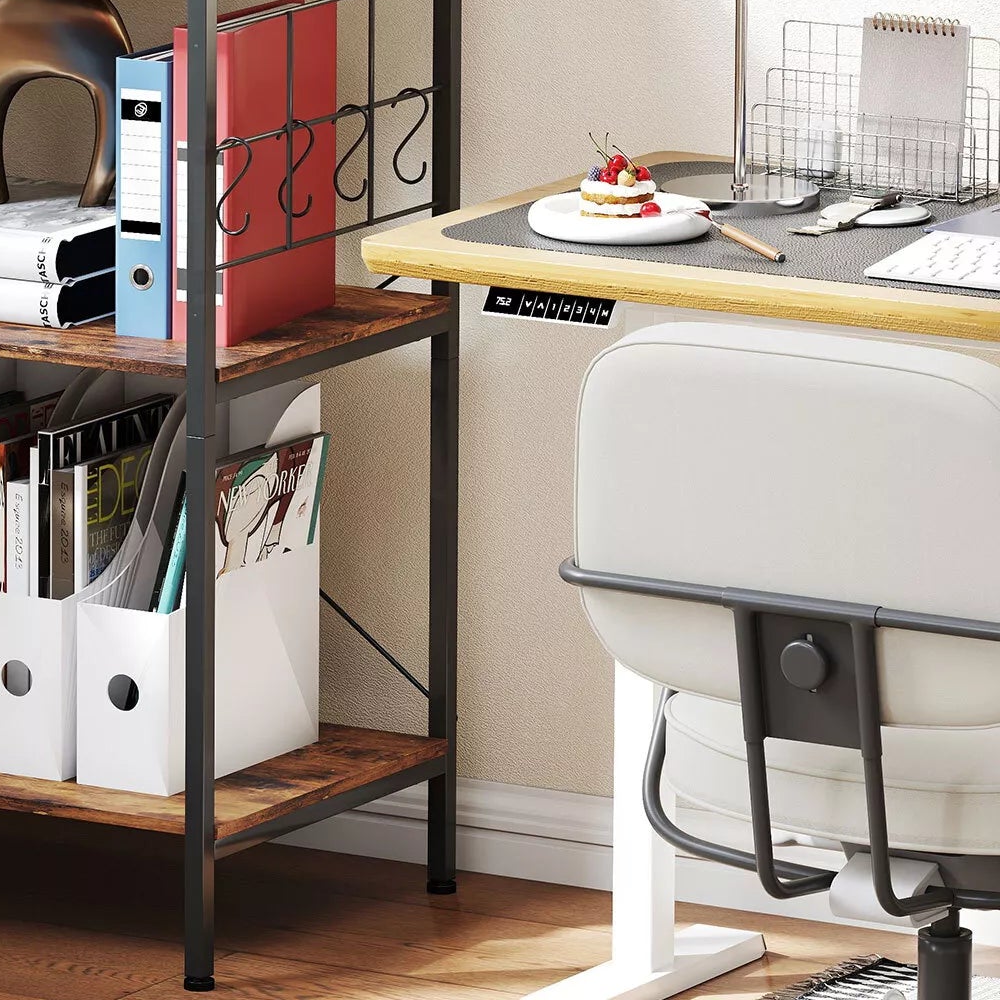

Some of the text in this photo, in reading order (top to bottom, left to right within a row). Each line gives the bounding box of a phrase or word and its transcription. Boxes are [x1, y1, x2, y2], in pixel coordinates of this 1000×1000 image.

[563, 304, 571, 313] 2
[575, 306, 583, 314] 3
[589, 307, 596, 316] 4
[601, 309, 609, 317] M
